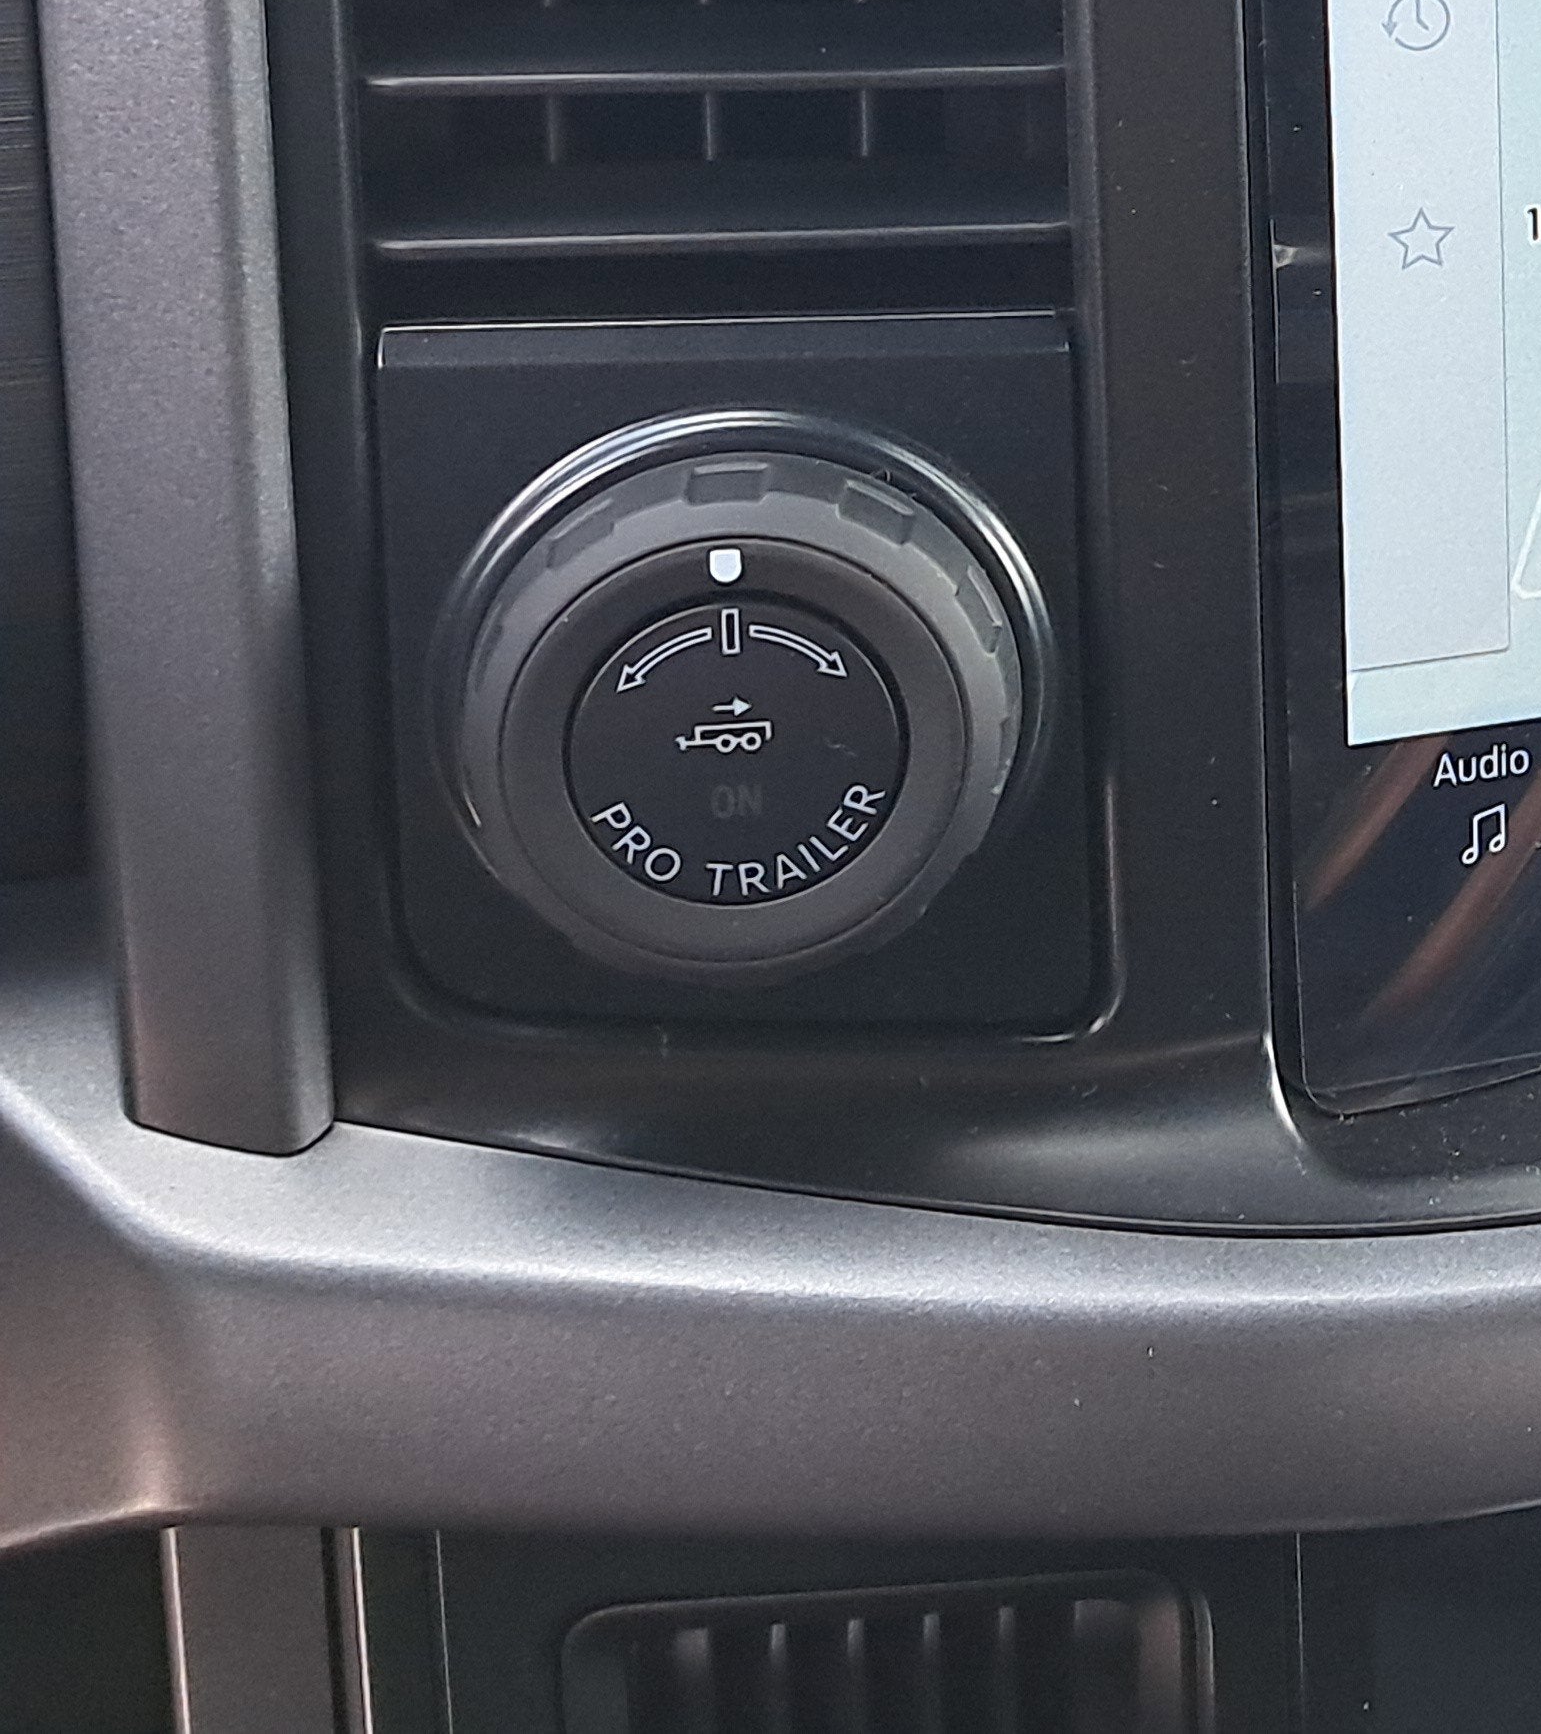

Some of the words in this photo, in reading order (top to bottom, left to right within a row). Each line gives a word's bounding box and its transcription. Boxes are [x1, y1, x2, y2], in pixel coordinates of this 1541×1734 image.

[1433, 743, 1531, 789] Audio
[590, 802, 682, 884] PRO
[705, 782, 887, 897] TRAILER
